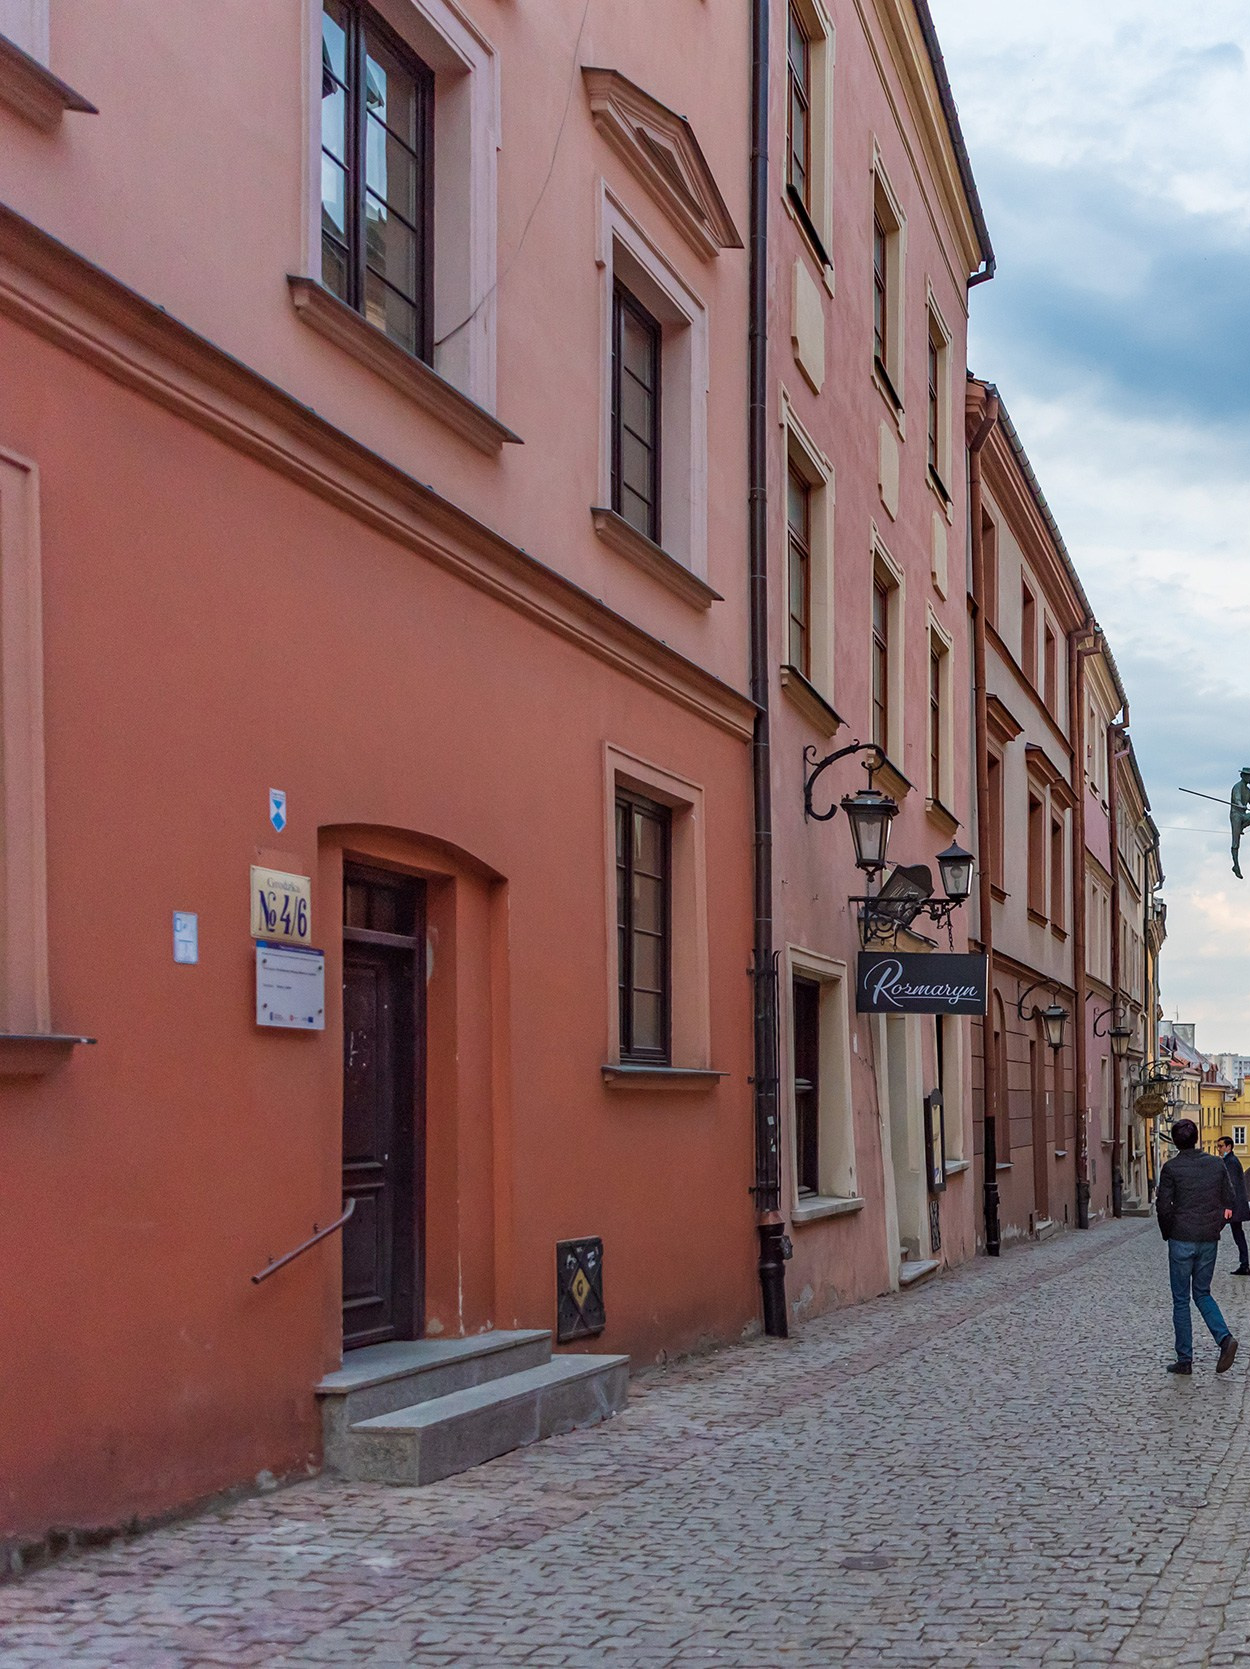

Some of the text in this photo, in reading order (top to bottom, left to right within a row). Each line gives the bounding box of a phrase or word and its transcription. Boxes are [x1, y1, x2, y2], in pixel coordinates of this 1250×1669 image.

[280, 894, 308, 938] 4/6
[863, 958, 980, 1008] Rozmaryn
[576, 1279, 584, 1297] G
